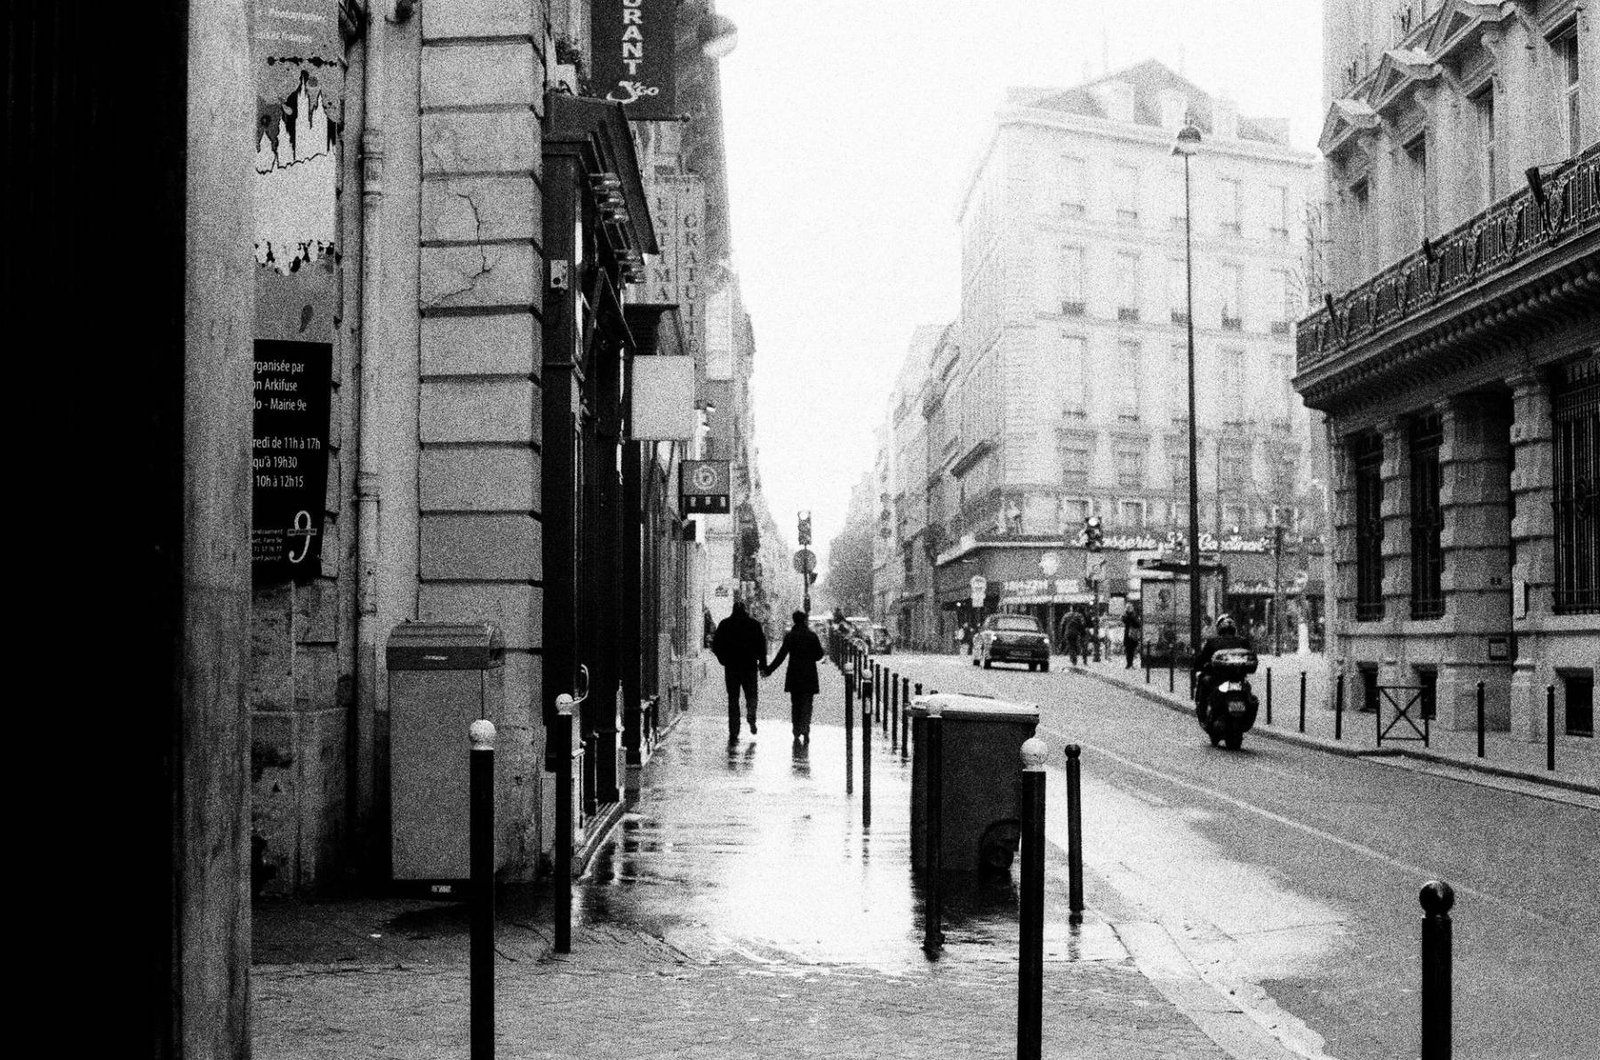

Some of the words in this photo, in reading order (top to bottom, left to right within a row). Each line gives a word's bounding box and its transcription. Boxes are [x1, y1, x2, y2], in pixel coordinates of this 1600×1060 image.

[291, 363, 305, 375] par
[264, 378, 298, 392] Arkifuse
[270, 397, 296, 411] Mairie
[297, 399, 307, 412] 9e
[271, 436, 282, 449] de
[284, 436, 298, 449] 11h
[307, 437, 321, 450] 17h
[273, 455, 298, 469] 19h30
[256, 475, 271, 488] 10h
[280, 475, 304, 488] 12h15
